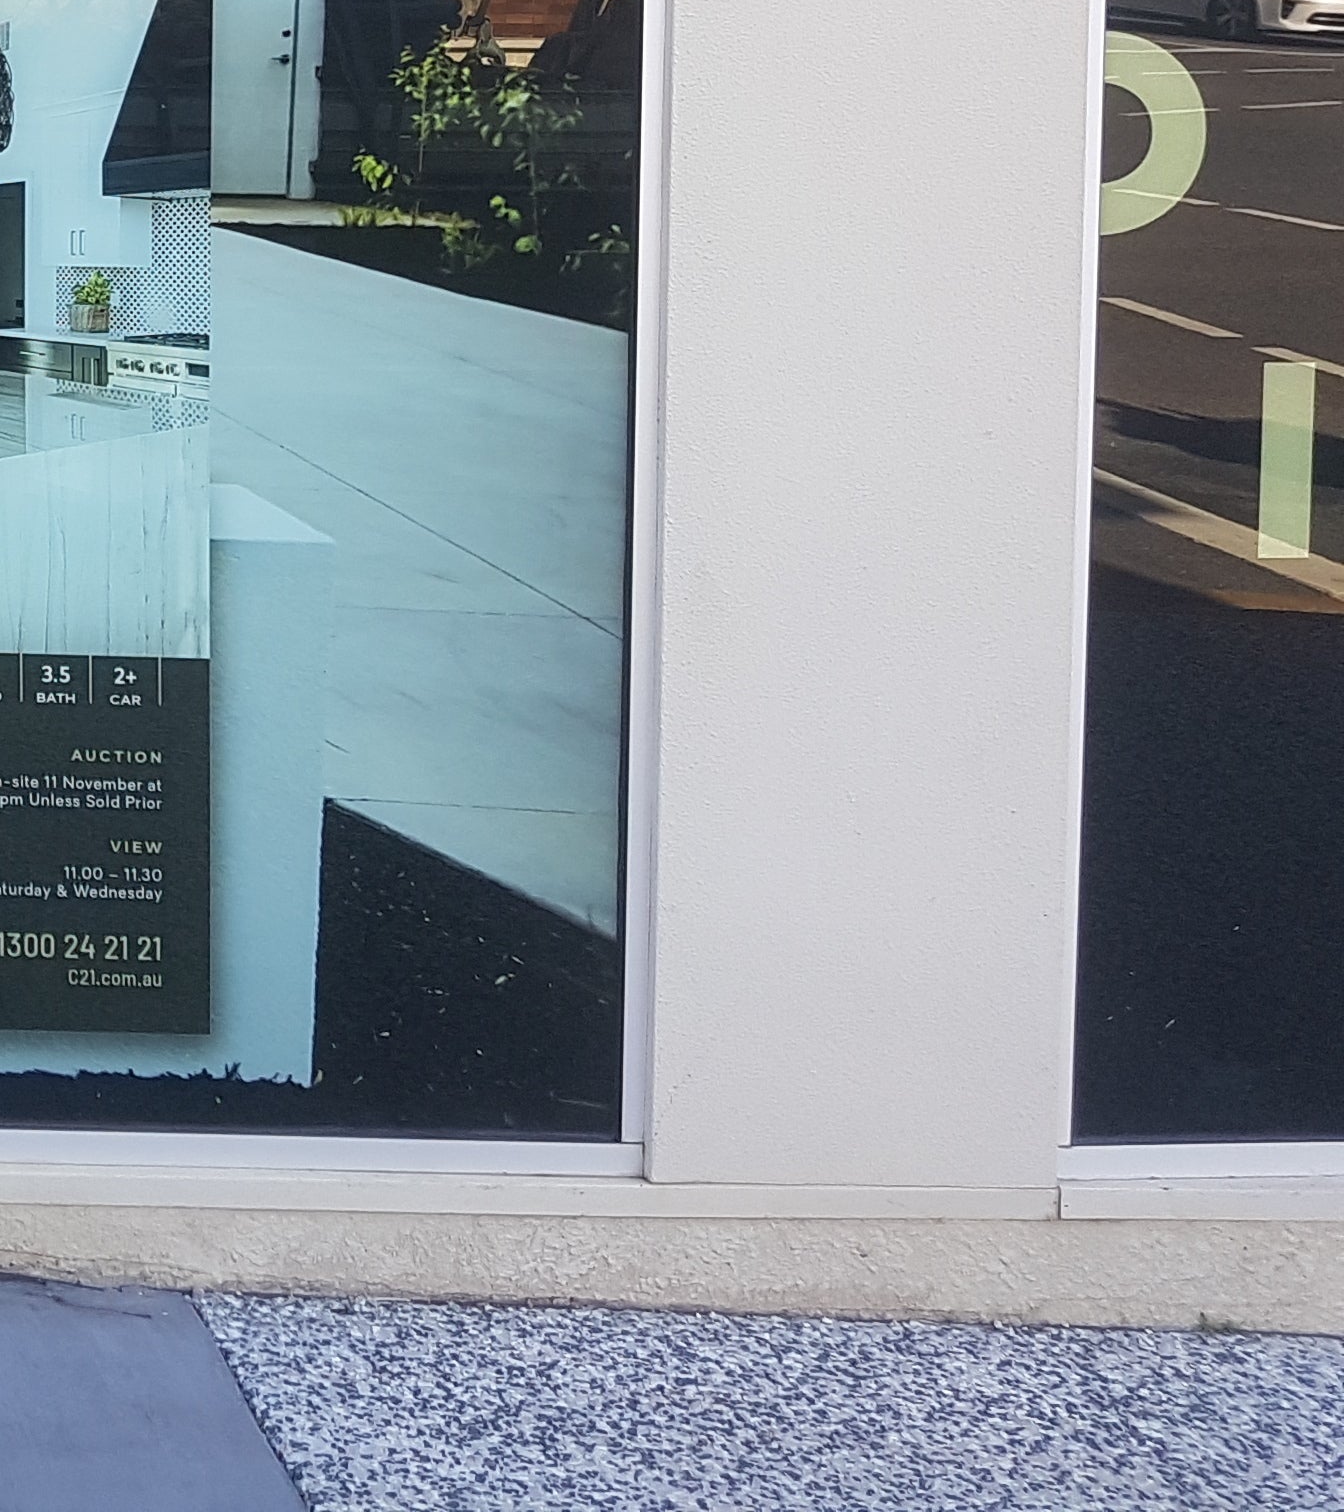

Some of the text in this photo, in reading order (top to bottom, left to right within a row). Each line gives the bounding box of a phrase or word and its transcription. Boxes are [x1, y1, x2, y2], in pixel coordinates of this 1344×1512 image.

[41, 665, 71, 684] 3.5
[113, 667, 137, 686] 2+
[36, 692, 76, 704] BATH
[110, 694, 142, 706] CAR
[71, 749, 162, 764] AUCTION
[44, 775, 57, 789] 11
[63, 776, 142, 792] November
[147, 780, 162, 792] at
[29, 793, 80, 808] Unless
[86, 794, 120, 809] Sold
[125, 796, 162, 810] Prior
[110, 840, 162, 854] VIEW
[64, 866, 103, 881] 11.00
[124, 868, 162, 882] 11.30
[57, 885, 68, 898] &
[73, 884, 162, 903] Wednesday
[64, 935, 96, 960] 24
[104, 936, 128, 961] 21
[137, 937, 162, 961] 21
[68, 969, 162, 987] C21.com.au
